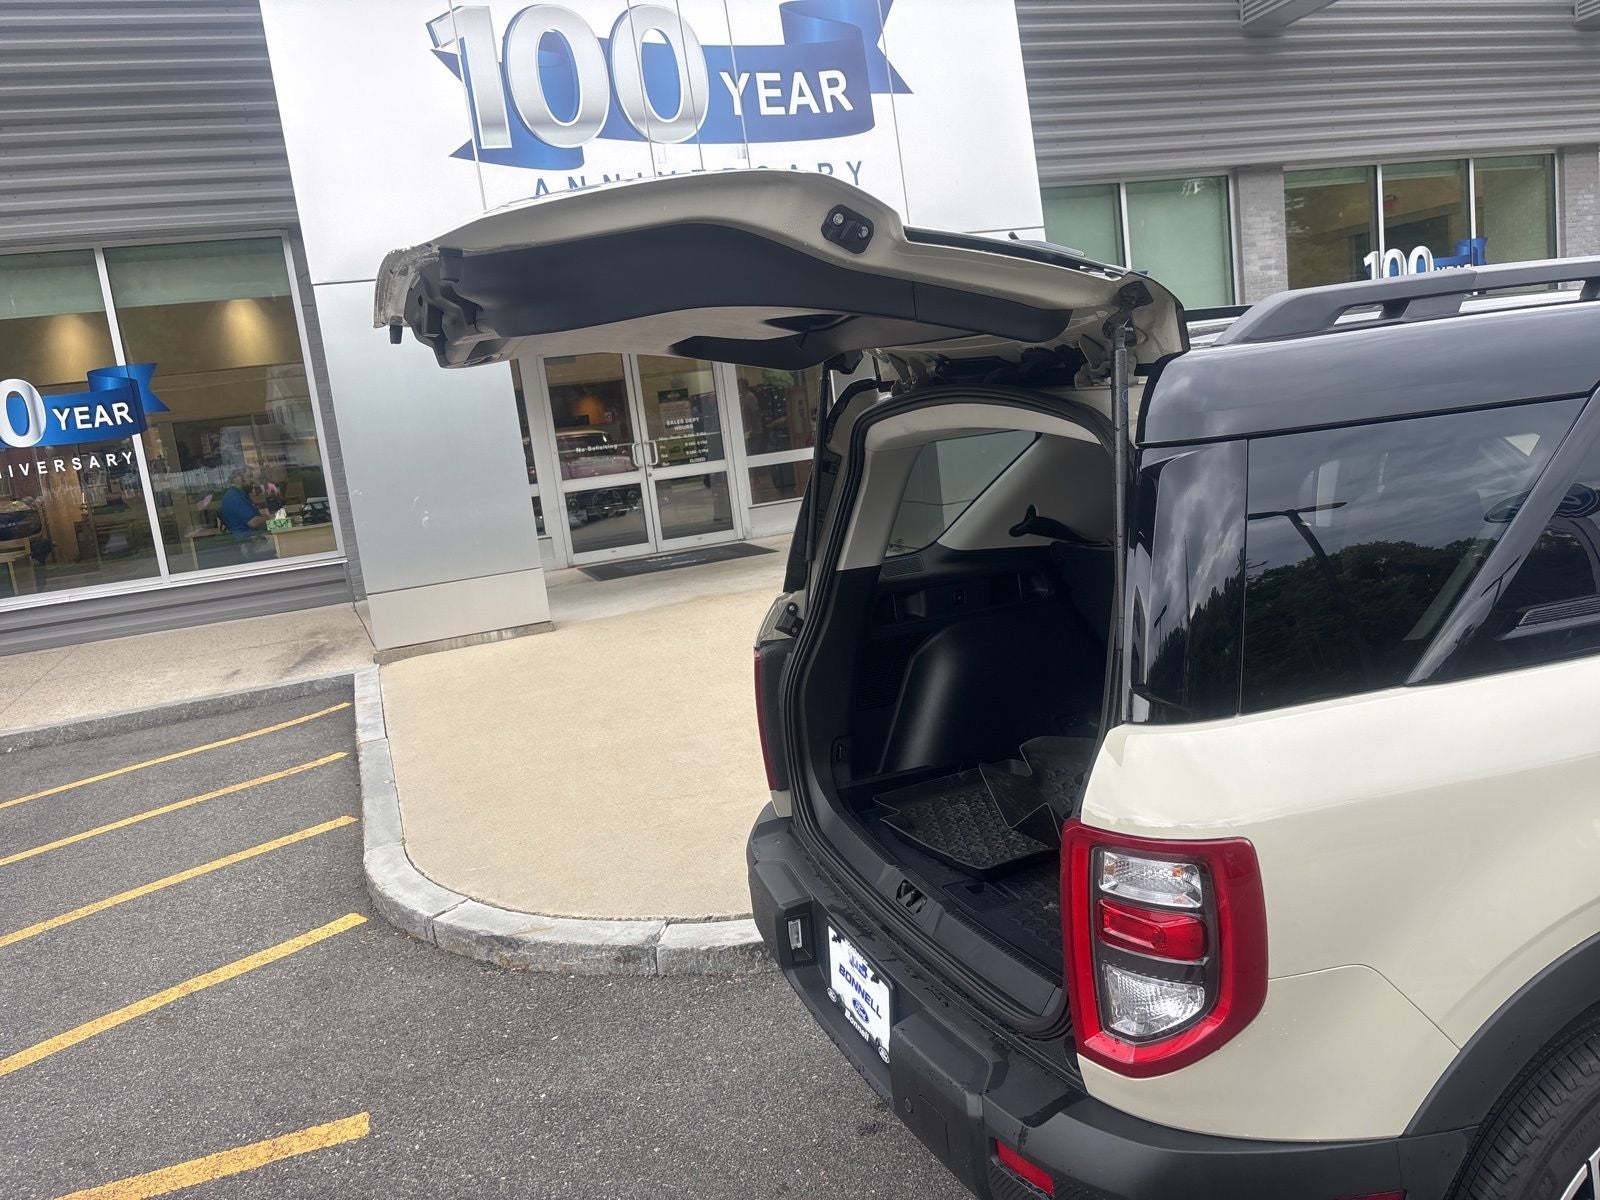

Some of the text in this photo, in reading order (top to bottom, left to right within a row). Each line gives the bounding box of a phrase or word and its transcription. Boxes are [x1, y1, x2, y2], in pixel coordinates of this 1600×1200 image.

[427, 3, 853, 149] 100 YEAR
[1363, 245, 1434, 280] 100
[52, 402, 133, 431] YEAR
[0, 451, 132, 479] IVERSARY
[839, 962, 882, 1019] BONNELL
[844, 1007, 870, 1042] Bonnell
